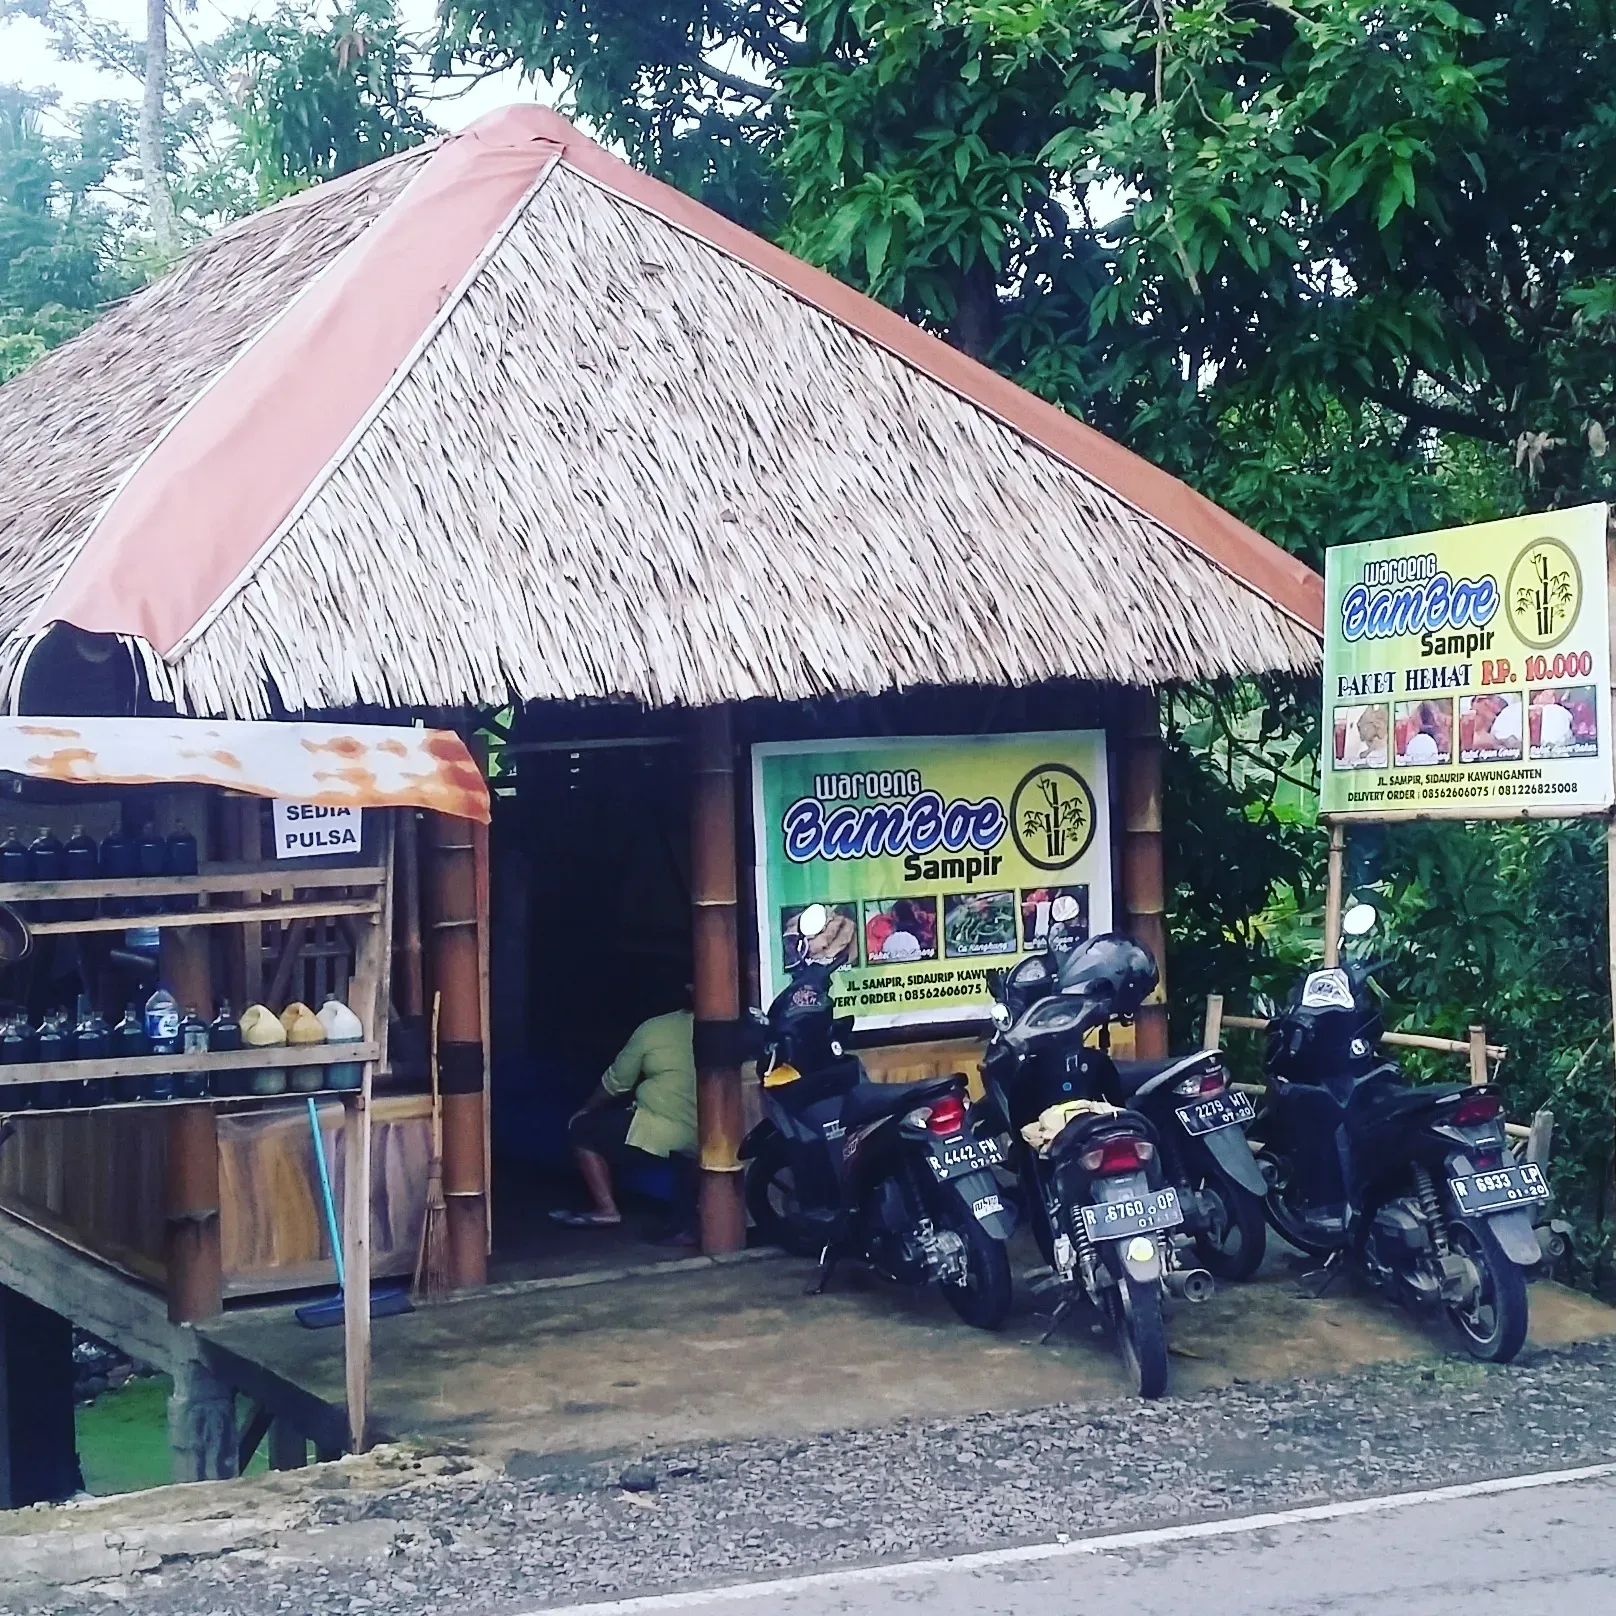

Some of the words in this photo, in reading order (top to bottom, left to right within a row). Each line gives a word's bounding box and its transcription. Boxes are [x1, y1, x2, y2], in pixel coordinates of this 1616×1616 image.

[1421, 627, 1494, 658] Sampir
[1337, 672, 1396, 697] PAKET
[1405, 664, 1472, 691] HEMAT
[1481, 659, 1517, 686] RP.
[1525, 651, 1592, 682] 10.000
[1389, 774, 1424, 787] SAMPIR,
[1425, 773, 1465, 785] SIDAURIP
[1467, 769, 1542, 782] KAWUNGANTEN
[1348, 791, 1385, 802] DELIVERY
[1386, 789, 1415, 800] ORDER
[1422, 786, 1489, 799] 08562606075
[1498, 782, 1578, 796] 081226825008
[286, 805, 351, 821] SEDIA
[285, 828, 357, 849] PULSA
[904, 850, 1003, 884] Sampir
[862, 976, 905, 990] SAMPIR,
[907, 972, 954, 986] SIDAURIP
[860, 991, 897, 1005] ORDER
[904, 983, 982, 1001] 08562606075
[1180, 1110, 1191, 1123] R
[1195, 1100, 1224, 1118] 2279
[929, 1156, 942, 1170] R
[944, 1145, 976, 1165] 4442
[978, 1138, 998, 1155] FN
[1455, 1181, 1469, 1197] R
[1475, 1173, 1512, 1192] 6933
[1520, 1167, 1538, 1184] LP
[1085, 1209, 1097, 1224] R
[1107, 1200, 1144, 1221] 6760
[1156, 1192, 1175, 1209] OP
